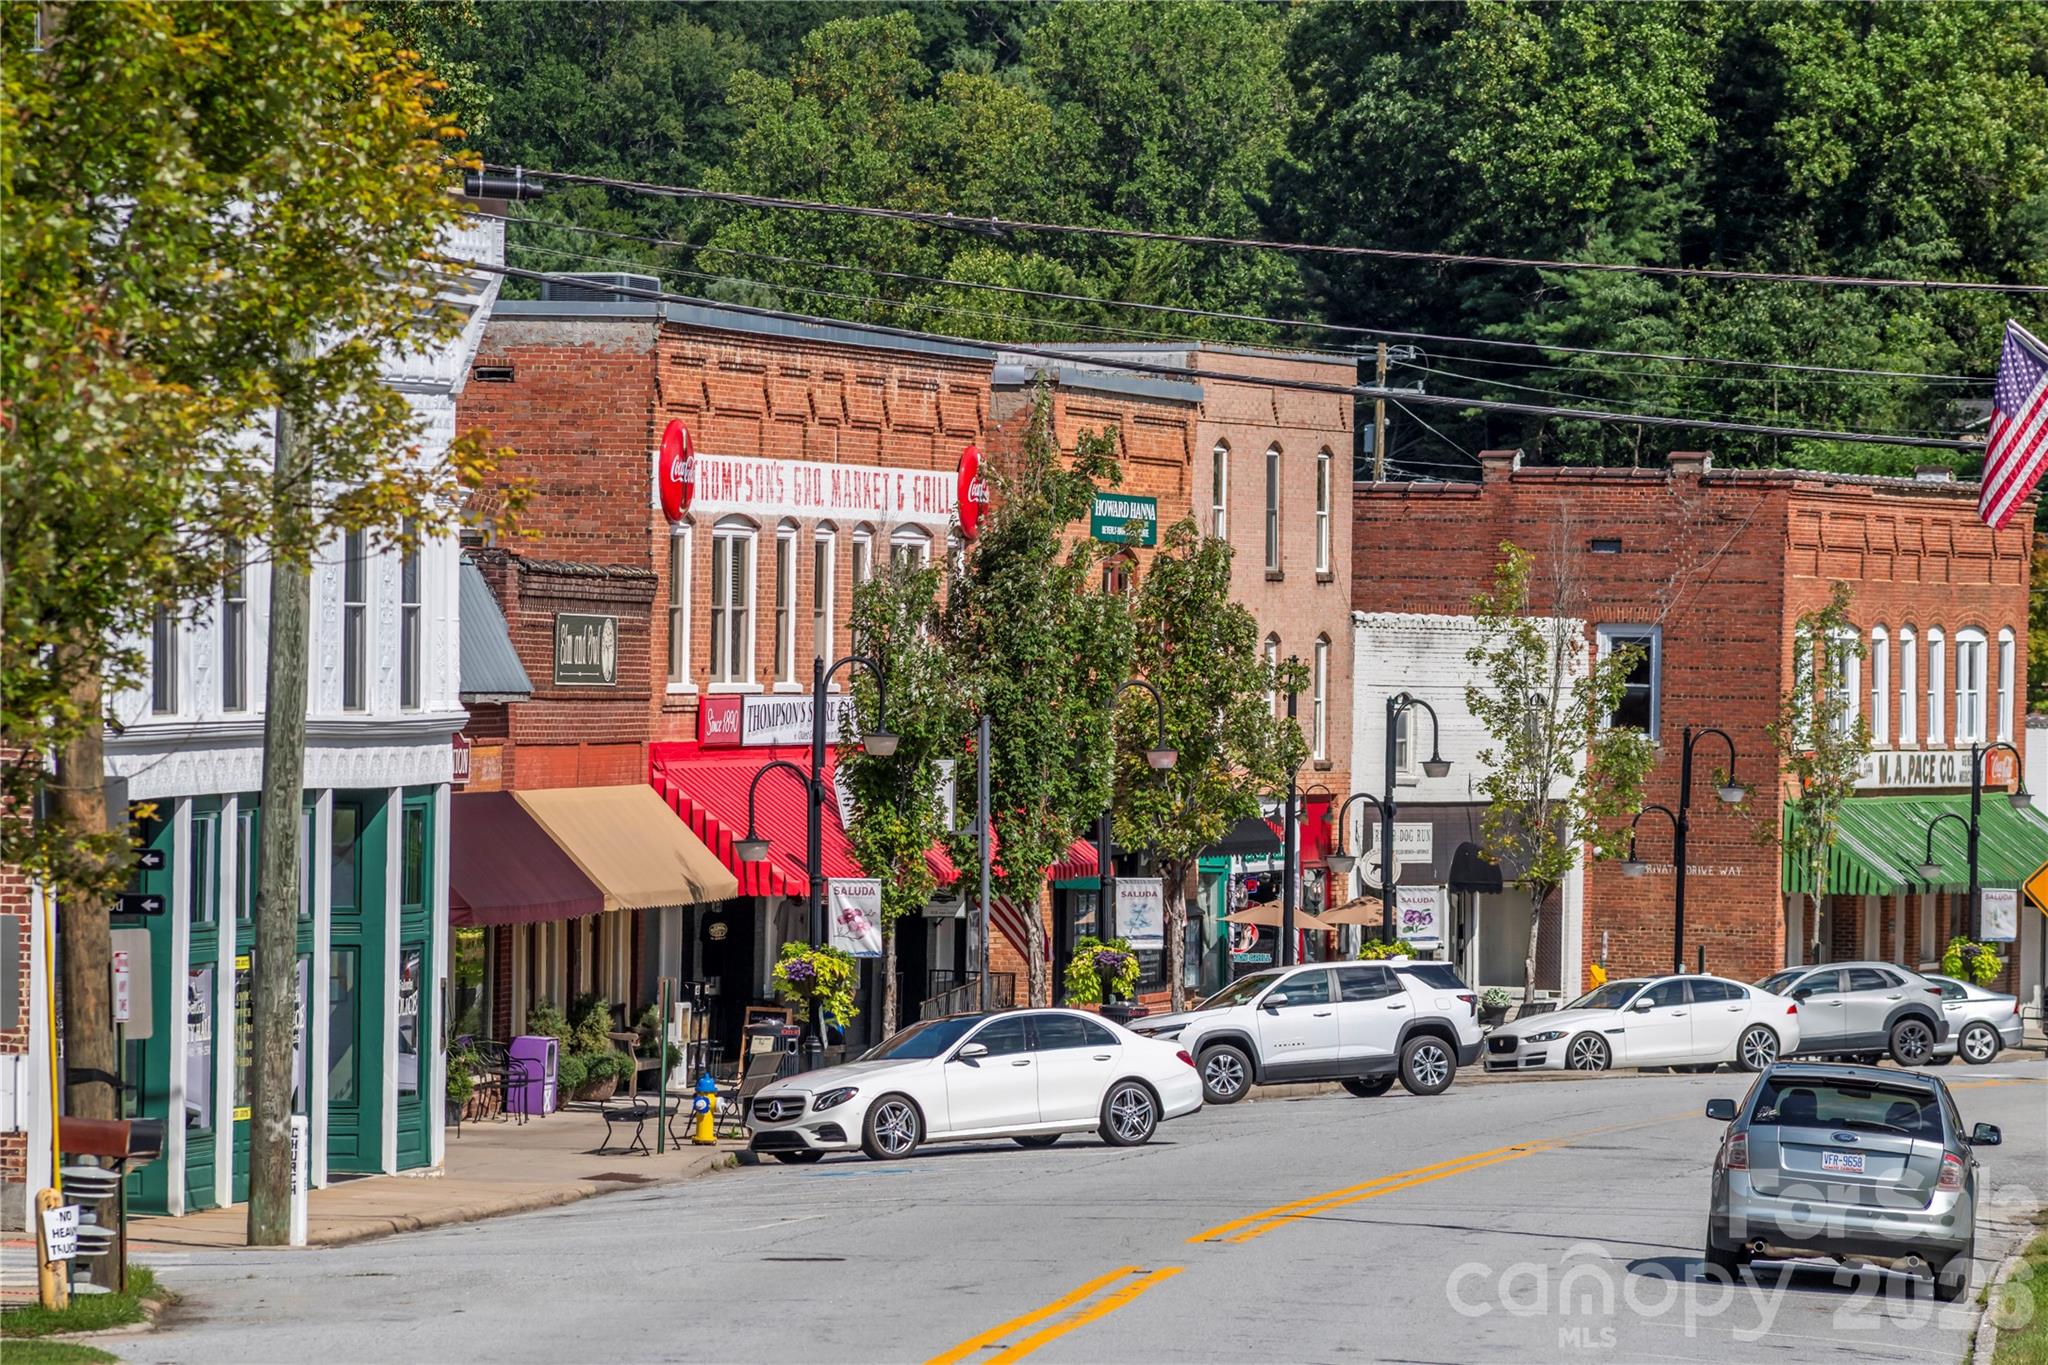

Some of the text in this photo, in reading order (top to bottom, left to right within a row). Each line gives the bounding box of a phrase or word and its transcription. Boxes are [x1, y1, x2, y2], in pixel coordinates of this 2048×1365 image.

[831, 468, 889, 511] MARKET
[913, 475, 952, 514] GRILL
[1095, 499, 1156, 520] HOWARD HANNA
[561, 623, 601, 665] Elm and Owl
[707, 707, 738, 736] Since 1890
[747, 702, 806, 733] THOMPSON'S
[808, 702, 836, 722] SRE
[453, 748, 469, 774] ION
[1907, 754, 1936, 784] PACE
[1940, 753, 1957, 783] CO.
[1400, 829, 1414, 842] DOG
[1416, 828, 1431, 842] RUN
[1645, 863, 1743, 876] RIVAT DRIVE WAY
[833, 886, 876, 896] SALUDA
[1121, 890, 1158, 898] SALUDA
[1985, 893, 2013, 901] SALUDA
[1823, 1153, 1863, 1168] VFR-9658
[59, 1210, 72, 1222] NO
[50, 1242, 77, 1255] TRUC
